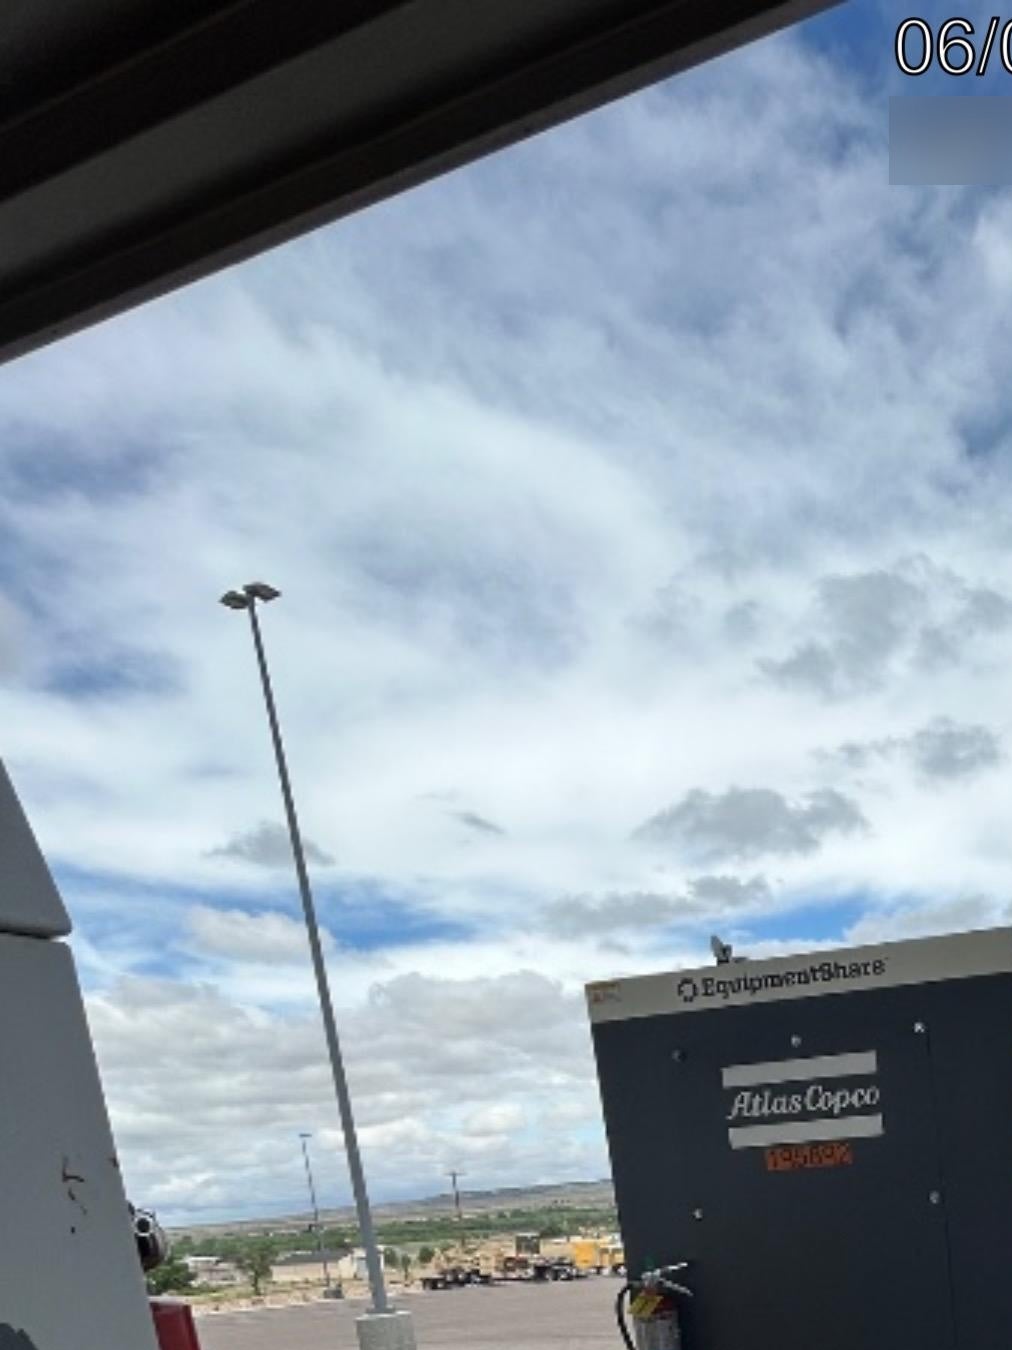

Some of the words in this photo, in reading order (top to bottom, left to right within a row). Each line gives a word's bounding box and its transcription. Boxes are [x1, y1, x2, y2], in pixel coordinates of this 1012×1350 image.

[702, 959, 886, 998] EquipmentShare
[727, 1091, 801, 1120] Atlas
[803, 1085, 880, 1115] Copco
